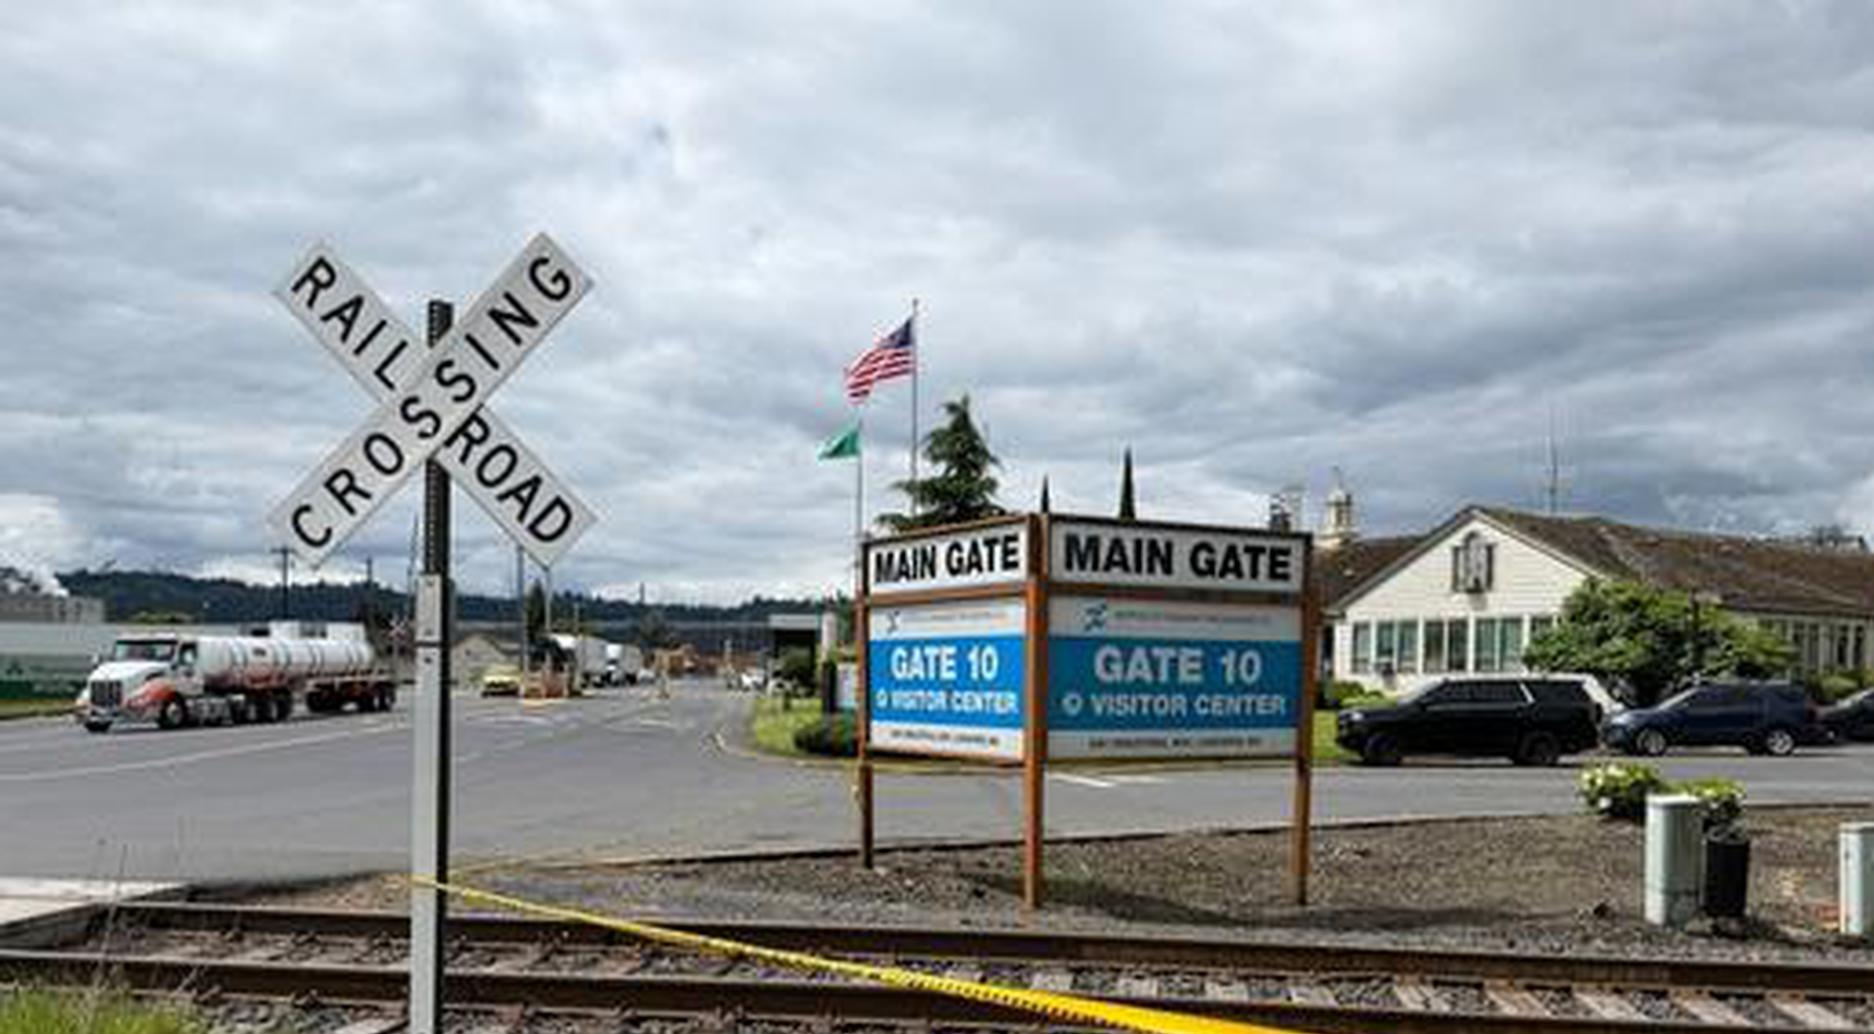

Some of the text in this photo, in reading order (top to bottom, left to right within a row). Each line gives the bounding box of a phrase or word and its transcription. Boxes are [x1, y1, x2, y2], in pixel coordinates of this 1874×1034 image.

[291, 256, 572, 549] CROSSING
[875, 534, 1019, 582] MAIN GATE
[1064, 533, 1291, 580] MAIN GATE
[892, 646, 998, 680] GATE 10
[1094, 647, 1263, 686] GATE 10
[892, 690, 1018, 713] VISITOR CENTER
[1089, 693, 1287, 717] VISITOR CENTER
